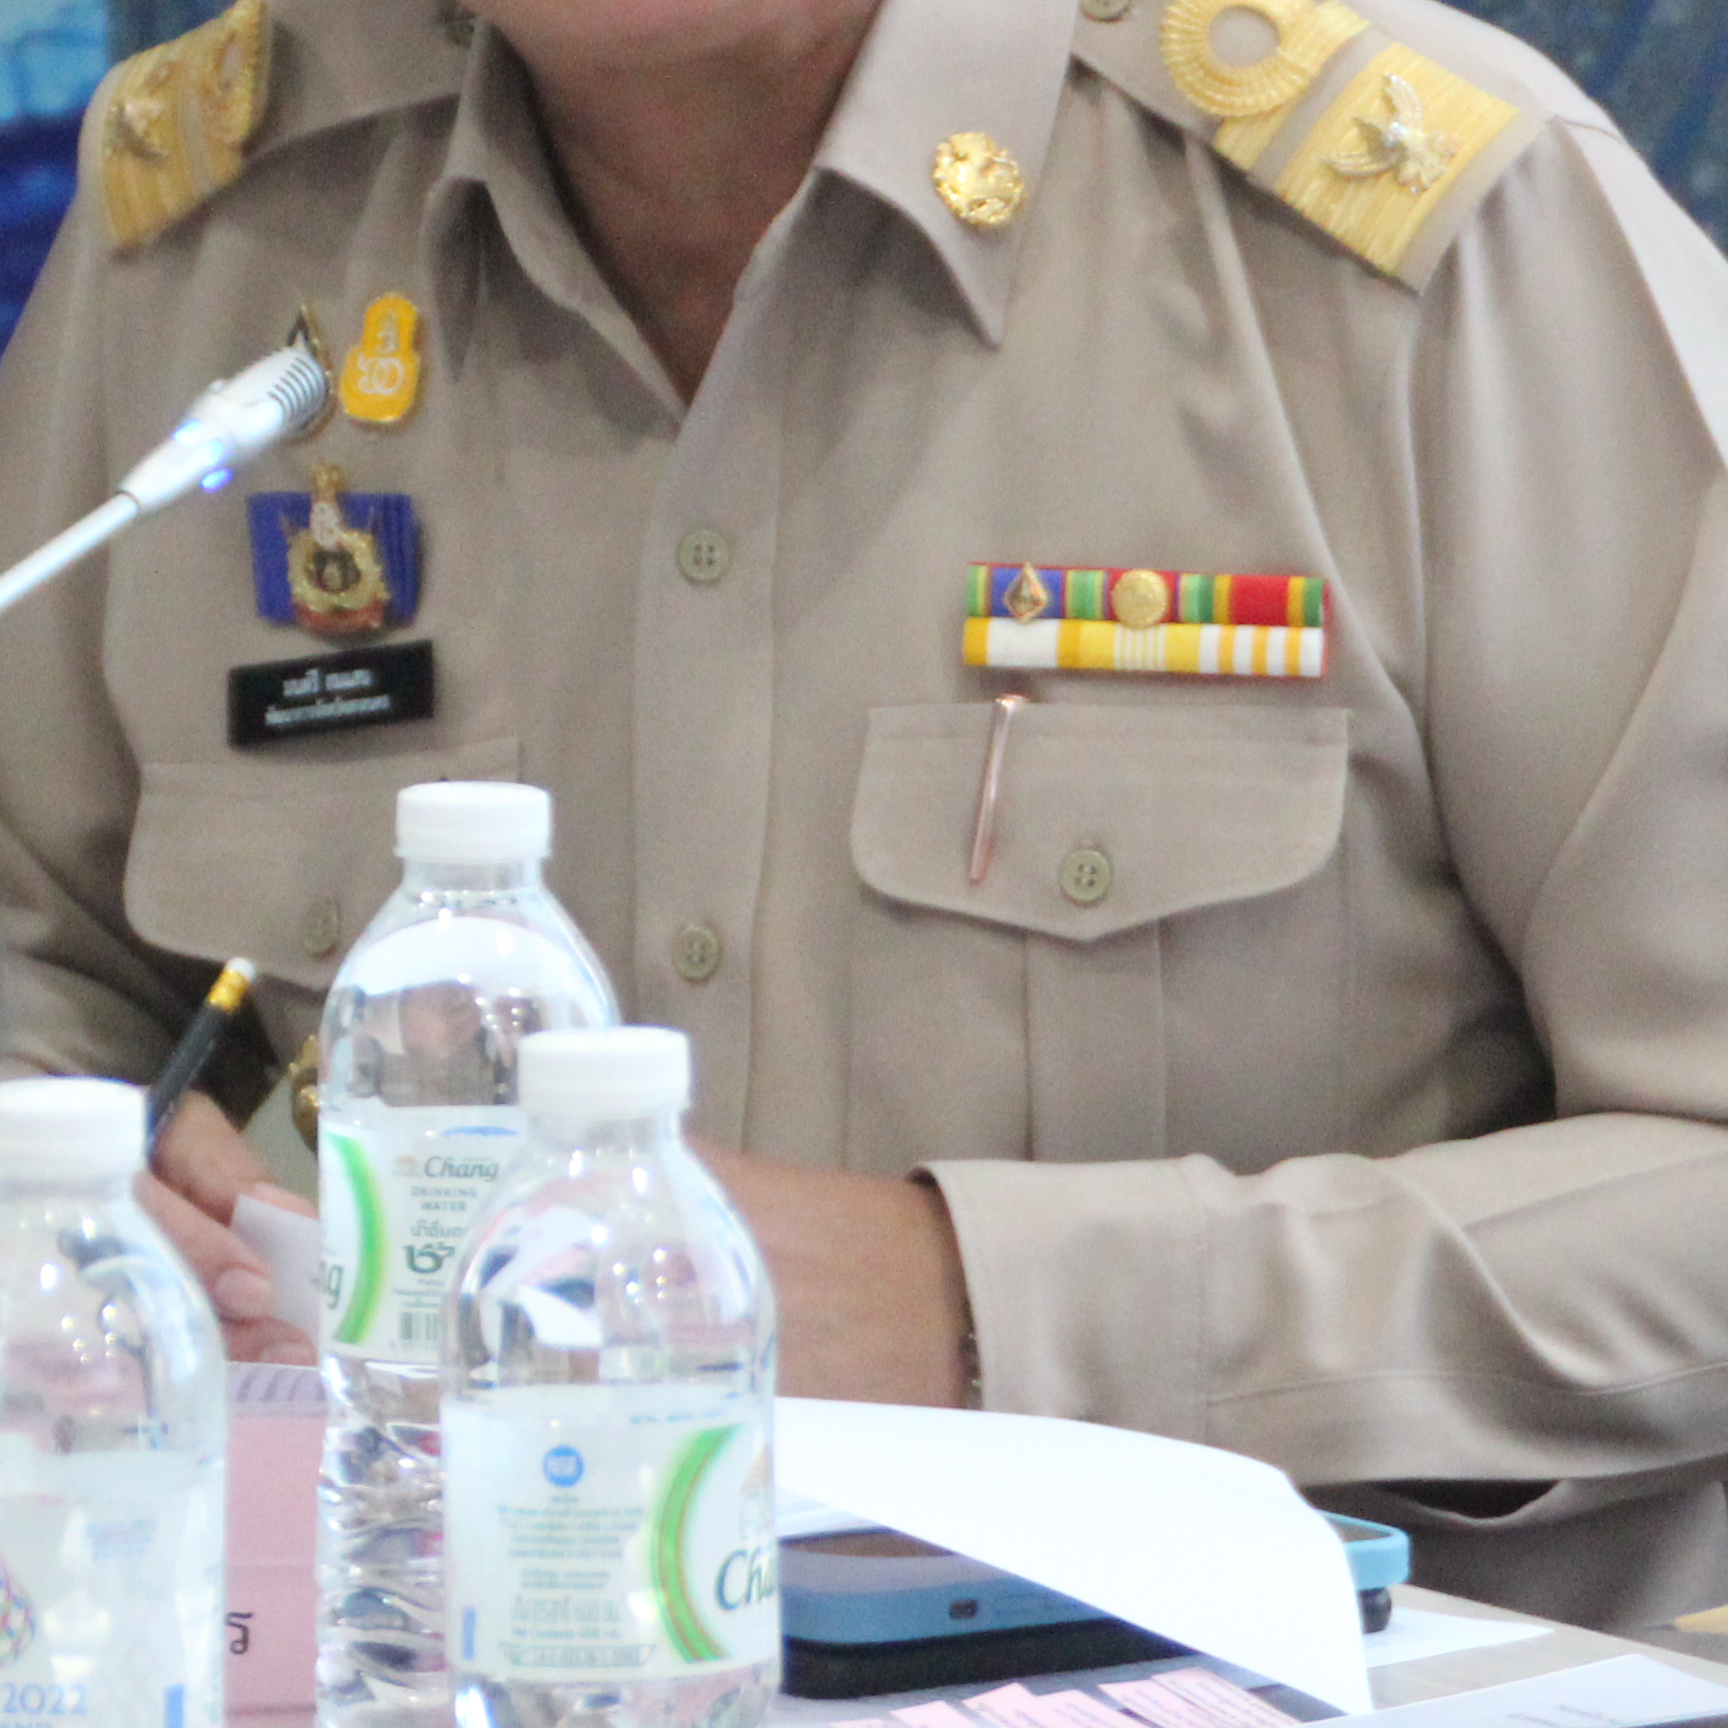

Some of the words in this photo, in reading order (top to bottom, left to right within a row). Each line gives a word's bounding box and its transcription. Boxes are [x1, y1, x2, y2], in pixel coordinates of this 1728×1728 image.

[423, 1155, 500, 1183] Chang
[420, 1201, 467, 1212] WATER
[0, 1682, 87, 1715] 2022
